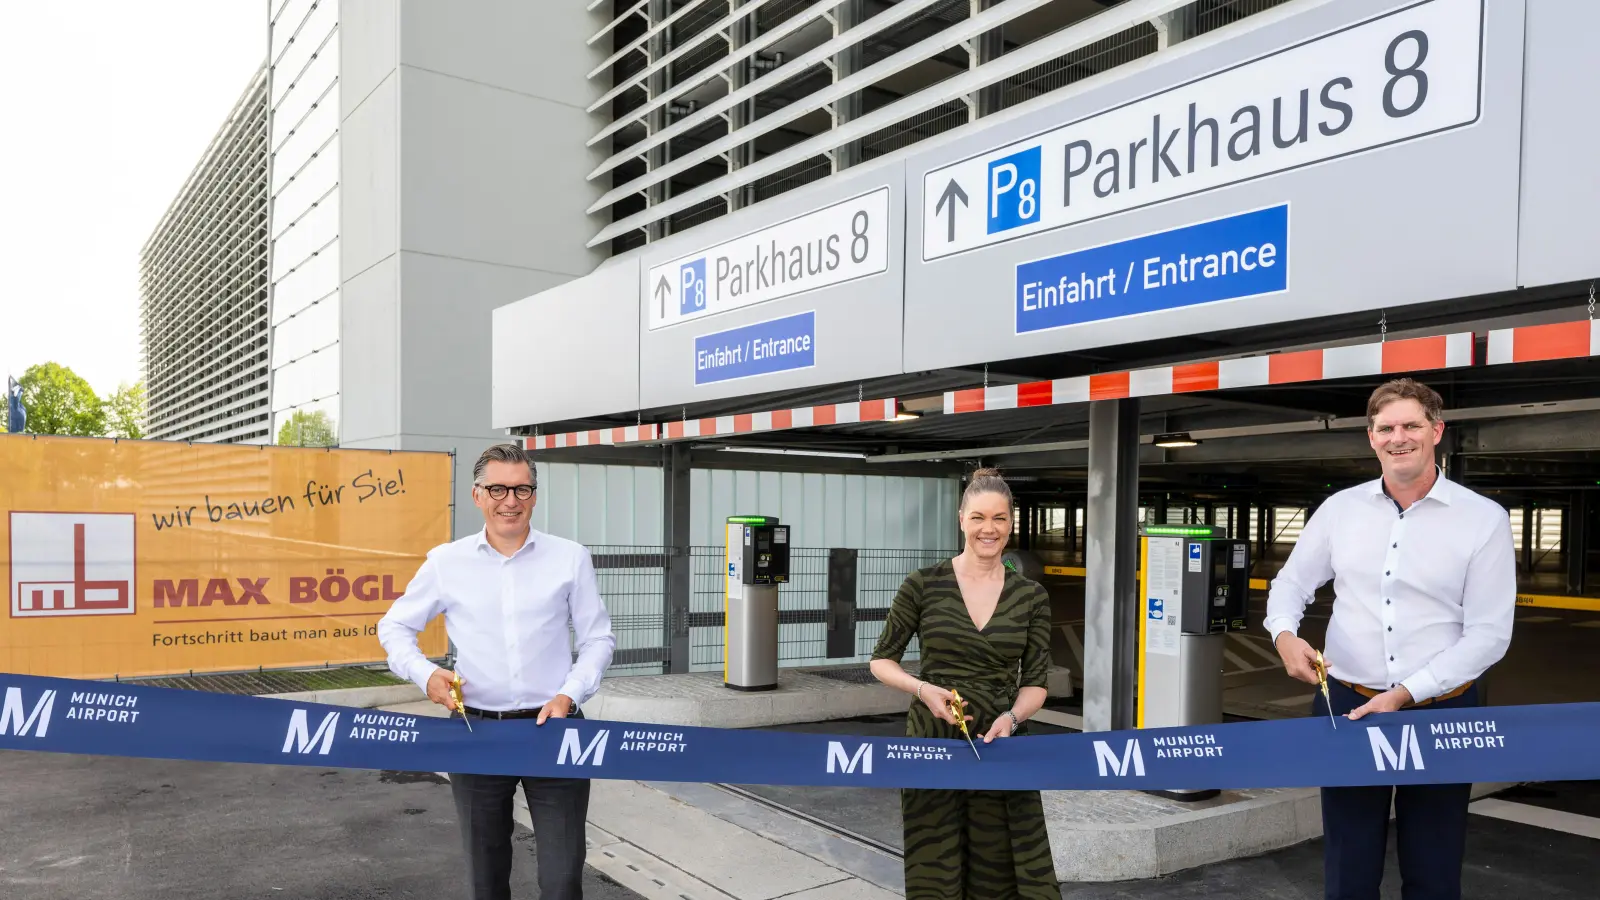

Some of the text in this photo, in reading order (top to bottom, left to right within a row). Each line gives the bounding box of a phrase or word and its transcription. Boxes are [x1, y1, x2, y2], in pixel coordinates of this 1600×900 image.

[1063, 76, 1354, 207] Parkhaus
[1382, 29, 1429, 118] 8
[716, 233, 841, 301] Parkhaus
[850, 209, 870, 264] 8
[1022, 241, 1277, 312] Einfahrt / Entrance
[697, 334, 811, 371] Einfahrt / Entrance
[152, 469, 406, 531] wir bauen für Sie!
[153, 568, 404, 609] MAX BÖGL
[152, 624, 377, 647] Fortschritt baut man aus Id
[70, 692, 138, 708] MUNICH
[66, 707, 140, 724] AIRPORT
[353, 713, 417, 728] MUNICH
[349, 726, 420, 743] AIRPORT
[622, 730, 684, 742] MUNICH
[1430, 720, 1497, 736] MUNICH
[619, 741, 688, 753] AIRPORT
[886, 743, 947, 753] MUNICH
[1153, 734, 1216, 747] MUNICH
[1434, 735, 1505, 750] AIRPORT
[886, 751, 953, 761] AIRPORT
[1156, 746, 1224, 758] AIRPORT
